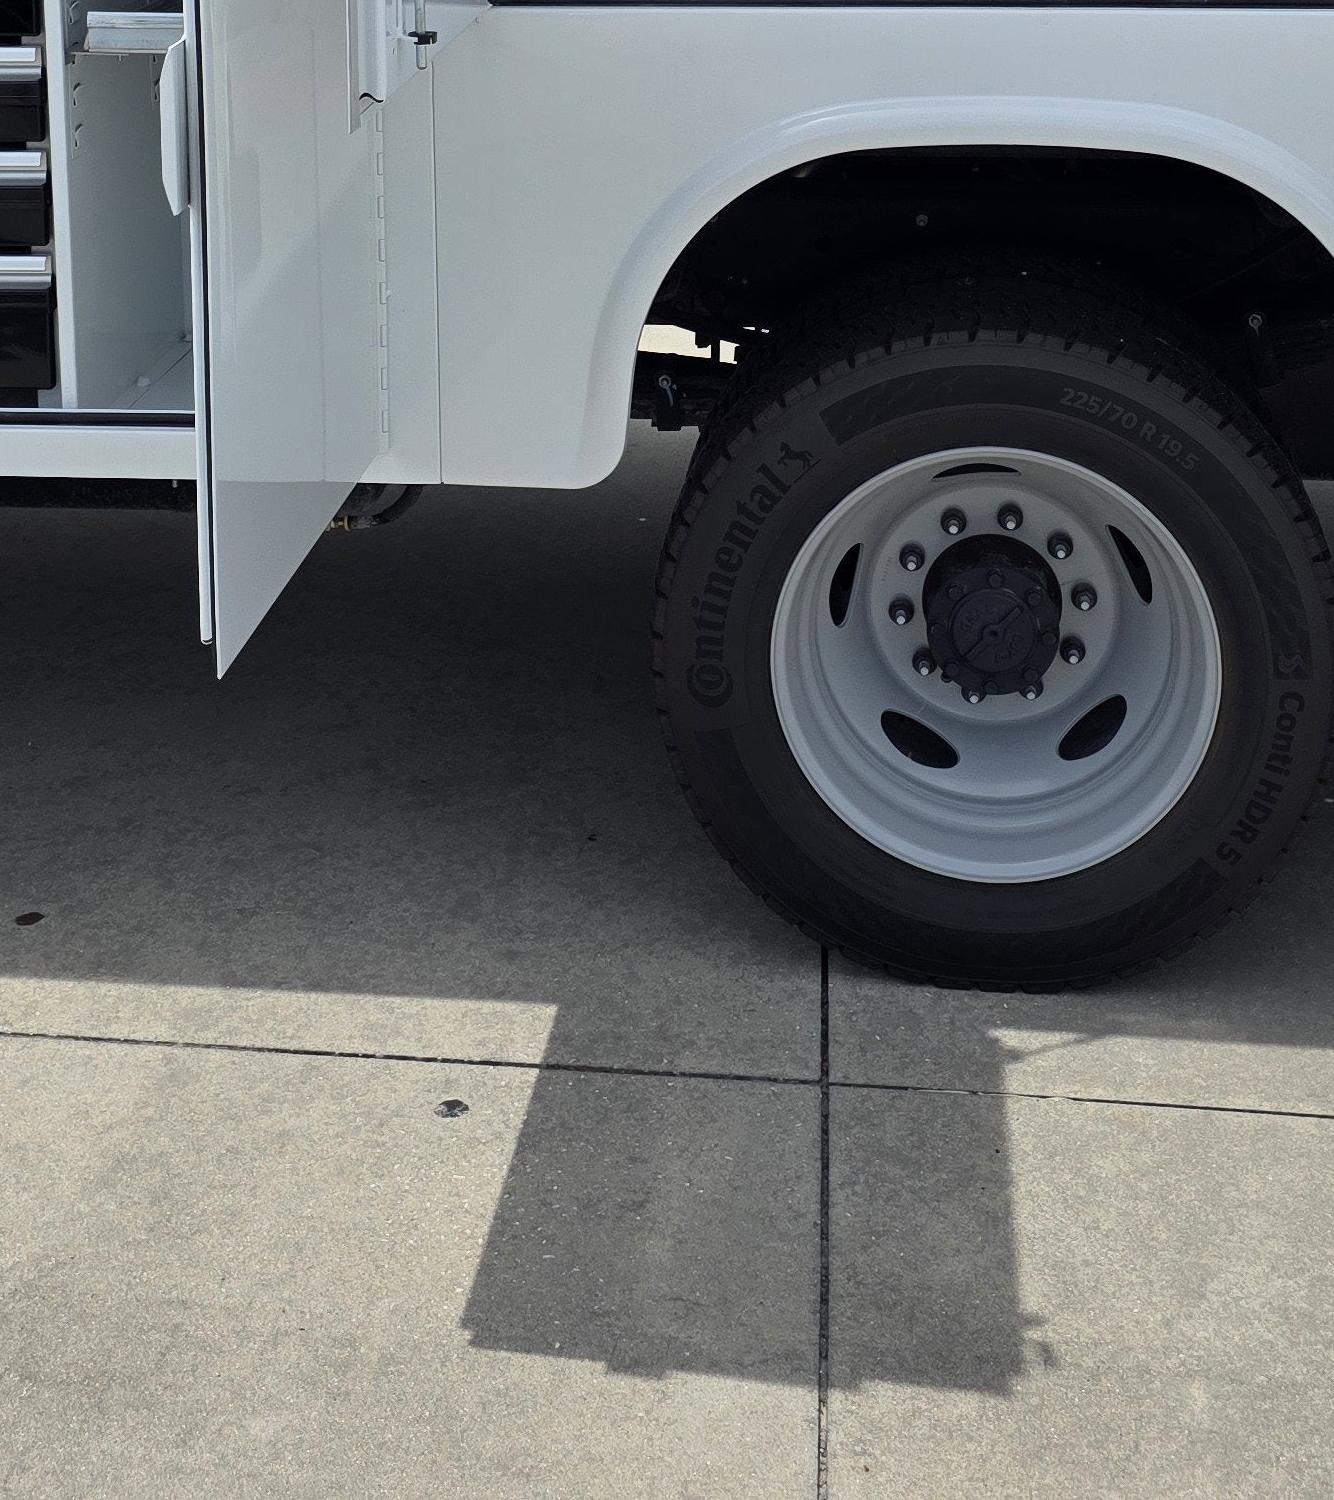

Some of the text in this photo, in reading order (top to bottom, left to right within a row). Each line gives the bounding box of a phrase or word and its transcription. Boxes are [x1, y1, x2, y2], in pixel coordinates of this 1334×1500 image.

[1059, 387, 1199, 470] 225/70 R 19.5
[685, 462, 793, 709] Continental
[1263, 690, 1305, 777] Conti
